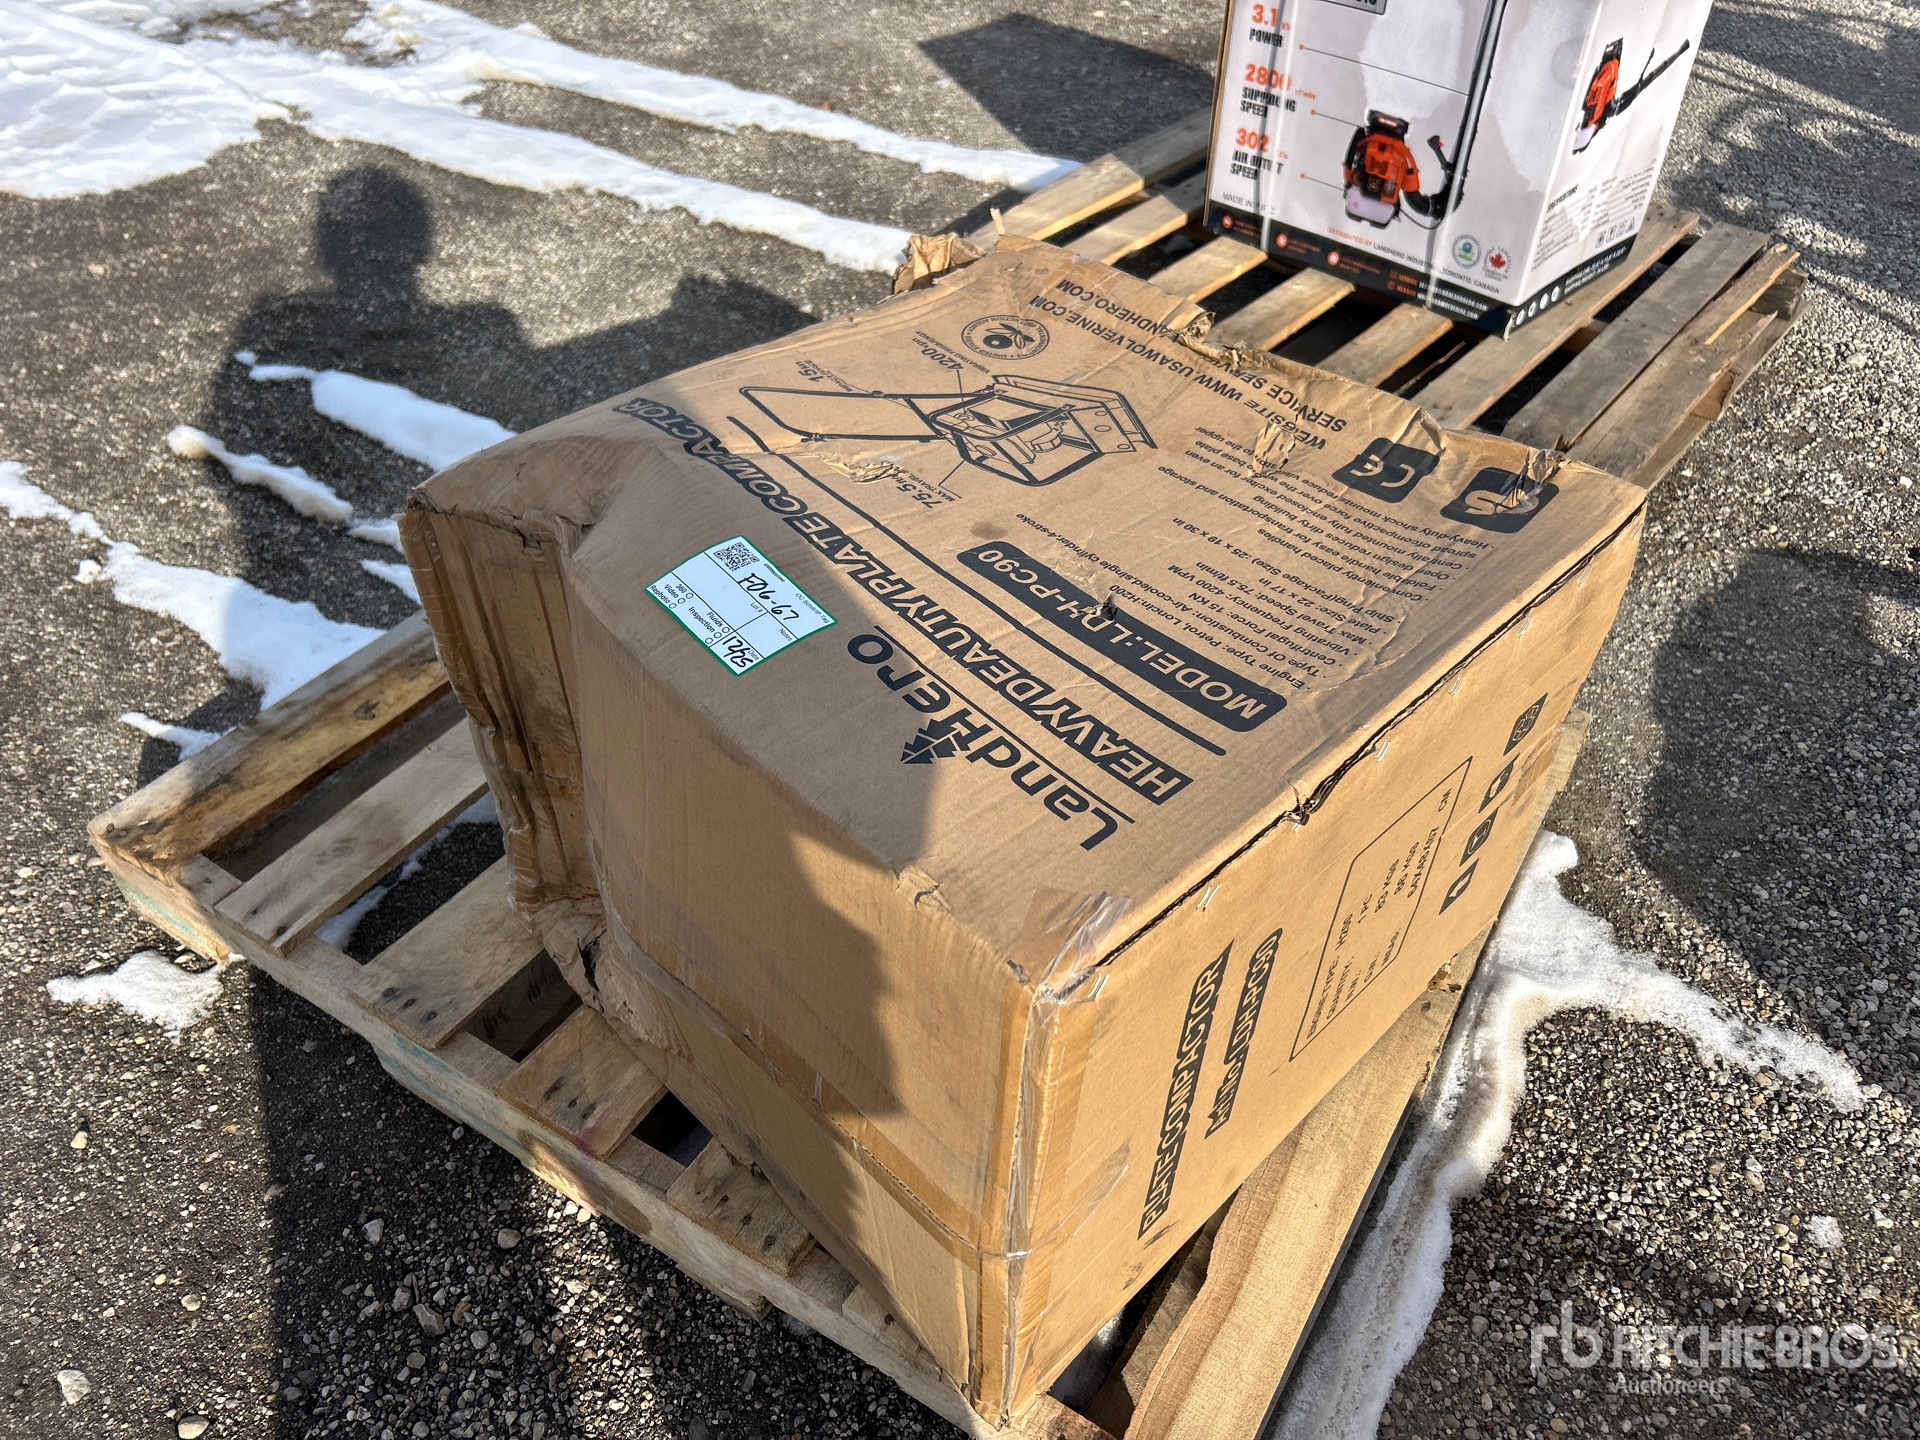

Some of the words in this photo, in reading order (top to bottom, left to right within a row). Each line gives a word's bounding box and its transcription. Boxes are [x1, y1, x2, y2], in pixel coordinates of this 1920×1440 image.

[1252, 4, 1278, 27] 3.1
[1249, 27, 1283, 48] POWER
[1029, 295, 1242, 401] WWW.USAWOLVERINE.COM
[954, 353, 990, 373] VIBRATING
[1266, 384, 1347, 432] SERVICE
[1194, 427, 1225, 442] upper
[1195, 441, 1222, 454] plate
[1225, 441, 1242, 450] the
[1185, 450, 1210, 463] even
[1221, 453, 1247, 466] base
[1210, 462, 1225, 470] an
[1224, 470, 1241, 478] for
[908, 474, 936, 492] TRAVEL
[1158, 467, 1197, 485] storage
[1195, 485, 1218, 495] and
[1240, 477, 1277, 495] exciter
[1279, 482, 1297, 491] the
[1301, 480, 1338, 499] reduce
[935, 491, 955, 501] MAX
[1296, 491, 1322, 504] over
[1218, 494, 1293, 533] transportation
[1253, 496, 1298, 521] building
[1276, 495, 1327, 520] enclosed
[1323, 504, 1352, 519] force
[1339, 498, 1381, 518] mounts
[1173, 518, 1185, 526] in
[1184, 524, 1199, 533] 30
[1297, 520, 1324, 533] dirty
[1327, 520, 1353, 534] fully
[1382, 516, 1418, 531] shock
[1257, 529, 1302, 554] handles
[1293, 533, 1311, 543] for
[1325, 533, 1371, 555] reduces
[1352, 532, 1406, 554] mounted
[1419, 528, 1489, 549] Heavy-duty
[793, 511, 902, 594] PLATE
[1312, 542, 1340, 556] easy
[1431, 546, 1476, 558] spread
[1252, 558, 1281, 575] Size)
[1301, 552, 1343, 572] placed
[1341, 555, 1382, 575] handle
[1373, 554, 1414, 570] design
[1407, 552, 1462, 569] Centrally
[1168, 565, 1195, 581] VPM
[1196, 562, 1229, 581] ft/min
[1415, 567, 1449, 580] Open
[1196, 580, 1225, 594] 4200
[1227, 580, 1254, 594] 75.5
[1259, 578, 1272, 586] in
[1270, 586, 1286, 594] 17
[1342, 571, 1422, 601] Conveniently
[650, 585, 670, 603] Rephoto
[736, 573, 799, 620] F06-67
[1188, 593, 1210, 605] KN
[1297, 597, 1315, 607] 22
[665, 584, 678, 598] Video
[689, 607, 715, 632] Inspection
[676, 584, 687, 593] 360
[707, 612, 723, 627] Fluids
[751, 602, 759, 610] Lot
[1208, 604, 1224, 612] 15
[1226, 594, 1293, 630] Frequency:
[1255, 593, 1297, 615] Speed:
[1315, 605, 1346, 621] Size:
[1226, 612, 1266, 634] Force:
[1296, 614, 1336, 634] Travel
[1365, 610, 1395, 622] Ship
[779, 629, 792, 641] Notes
[1183, 623, 1222, 647] Petrol,
[1192, 611, 1268, 652] Combustion:
[1348, 619, 1381, 633] Plate
[1294, 627, 1349, 655] Vibrating
[1338, 631, 1367, 644] Max
[748, 650, 759, 660] Date
[892, 592, 1044, 702] DEAUTY
[1222, 645, 1256, 666] Type:
[1265, 632, 1336, 665] Centrifugal
[1267, 651, 1286, 661] Of
[1259, 664, 1305, 689] Engine
[1288, 660, 1319, 677] Type
[1034, 696, 1181, 797] HEAVY
[1438, 788, 1452, 812] CM
[1360, 894, 1372, 915] PC
[1358, 915, 1366, 923] 1
[1307, 993, 1328, 1039] ENGINE
[1322, 956, 1339, 996] TYPE:
[1335, 914, 1353, 951] H200
[1327, 956, 1354, 1019] QUANTITY:
[1229, 936, 1277, 1059] LDH-PC90
[1143, 1143, 1178, 1231] PLATE
[1162, 957, 1222, 1149] COMPACTOR
